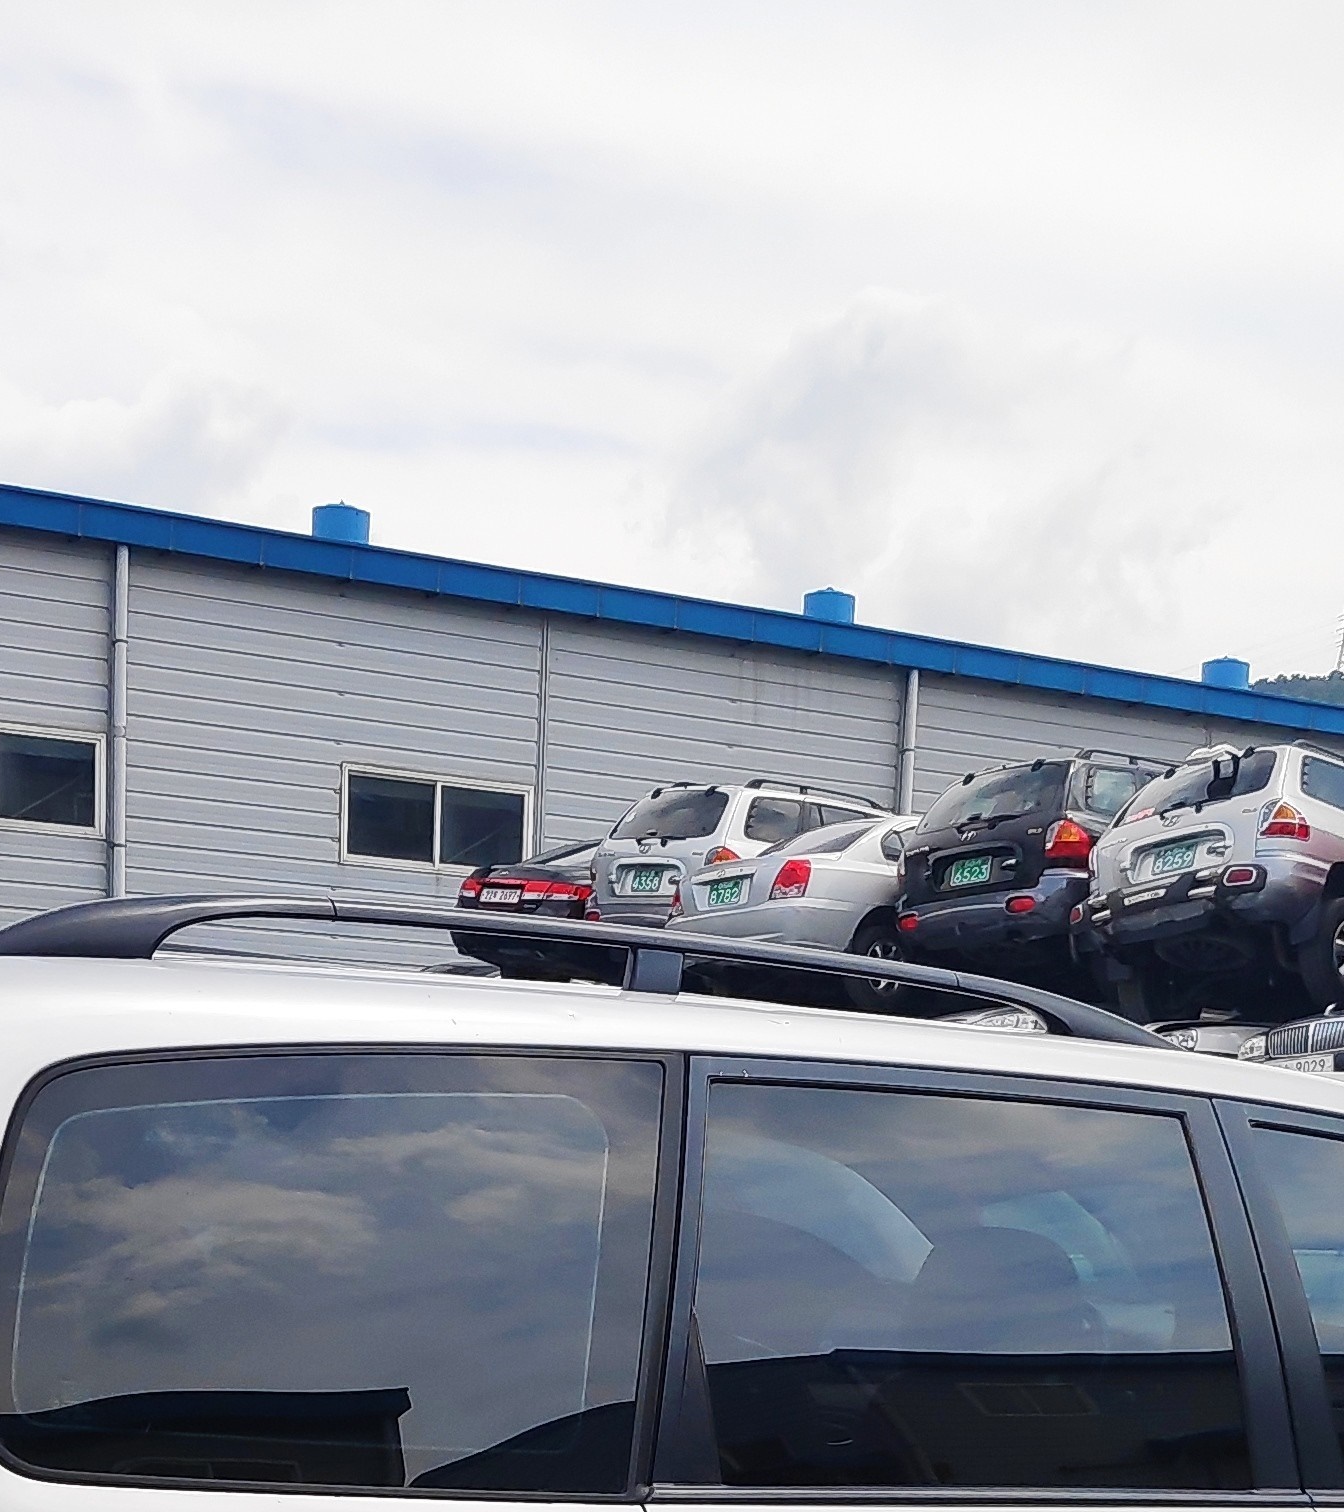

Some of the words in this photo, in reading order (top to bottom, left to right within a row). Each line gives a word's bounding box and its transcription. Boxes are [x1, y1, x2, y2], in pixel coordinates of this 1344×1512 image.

[1153, 851, 1194, 874] 8259
[953, 864, 988, 883] 6523
[632, 876, 660, 890] 4358
[709, 887, 740, 904] 8782
